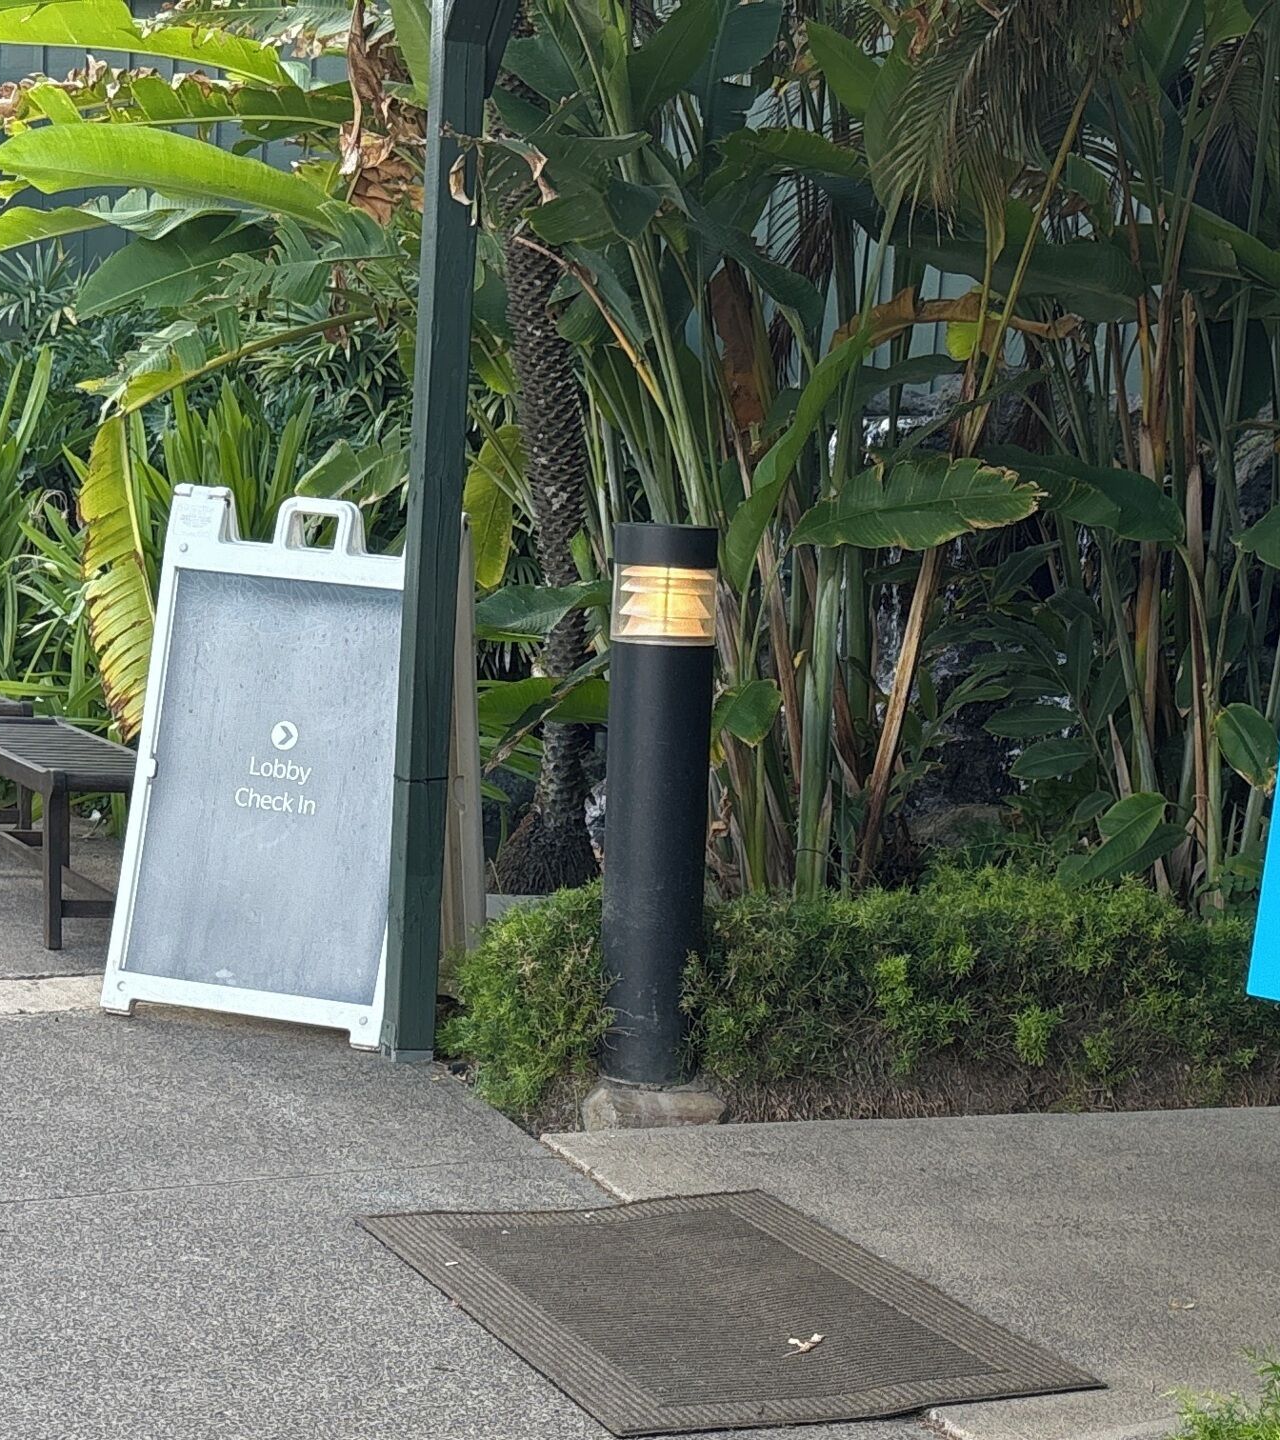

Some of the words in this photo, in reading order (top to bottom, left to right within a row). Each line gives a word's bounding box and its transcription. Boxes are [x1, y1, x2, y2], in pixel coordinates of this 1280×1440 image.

[249, 756, 312, 785] Lobby
[234, 787, 295, 813] Check
[297, 794, 316, 815] In
